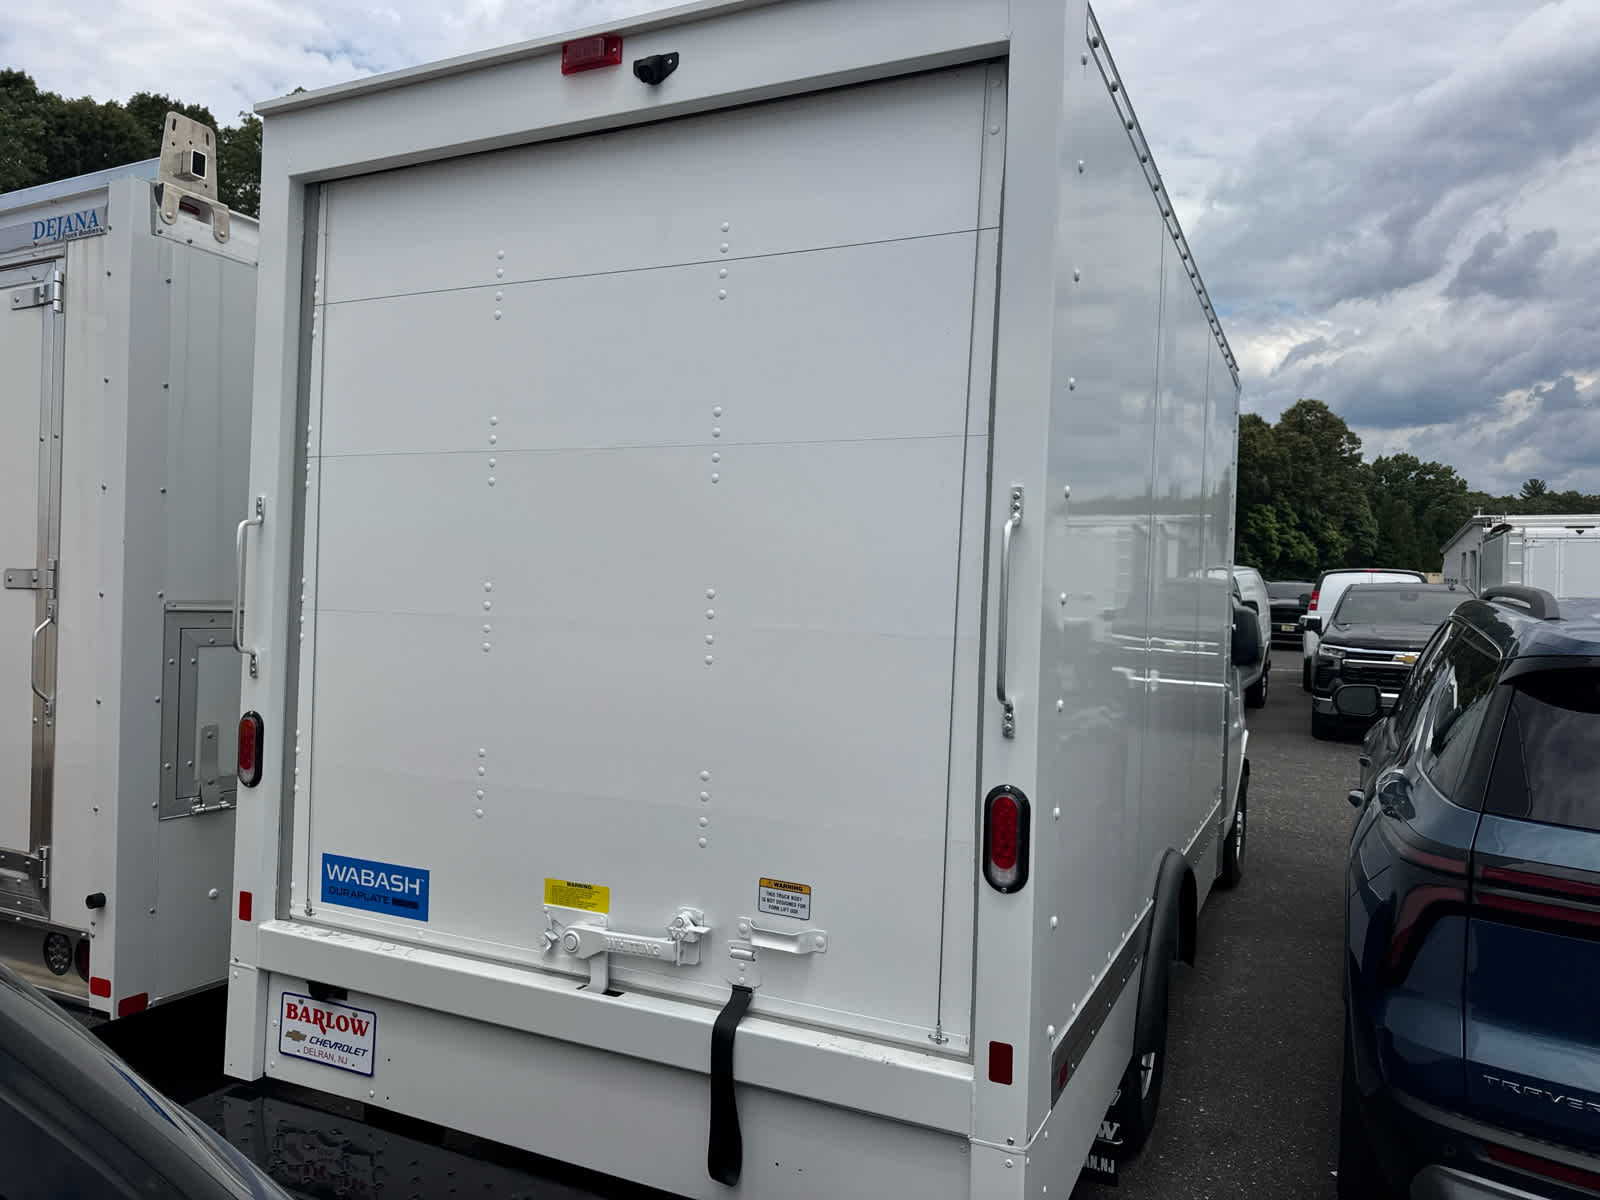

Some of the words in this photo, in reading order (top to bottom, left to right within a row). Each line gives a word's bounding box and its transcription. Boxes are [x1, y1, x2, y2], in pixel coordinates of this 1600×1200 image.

[33, 208, 99, 241] DEJANA
[773, 881, 803, 892] WARNING
[328, 886, 391, 905] DURAPLATE
[776, 892, 790, 900] TRUCK
[768, 904, 780, 912] FORK
[286, 1002, 370, 1037] BARLOW
[309, 1036, 368, 1057] CHEVROLET
[338, 1055, 348, 1065] NJ
